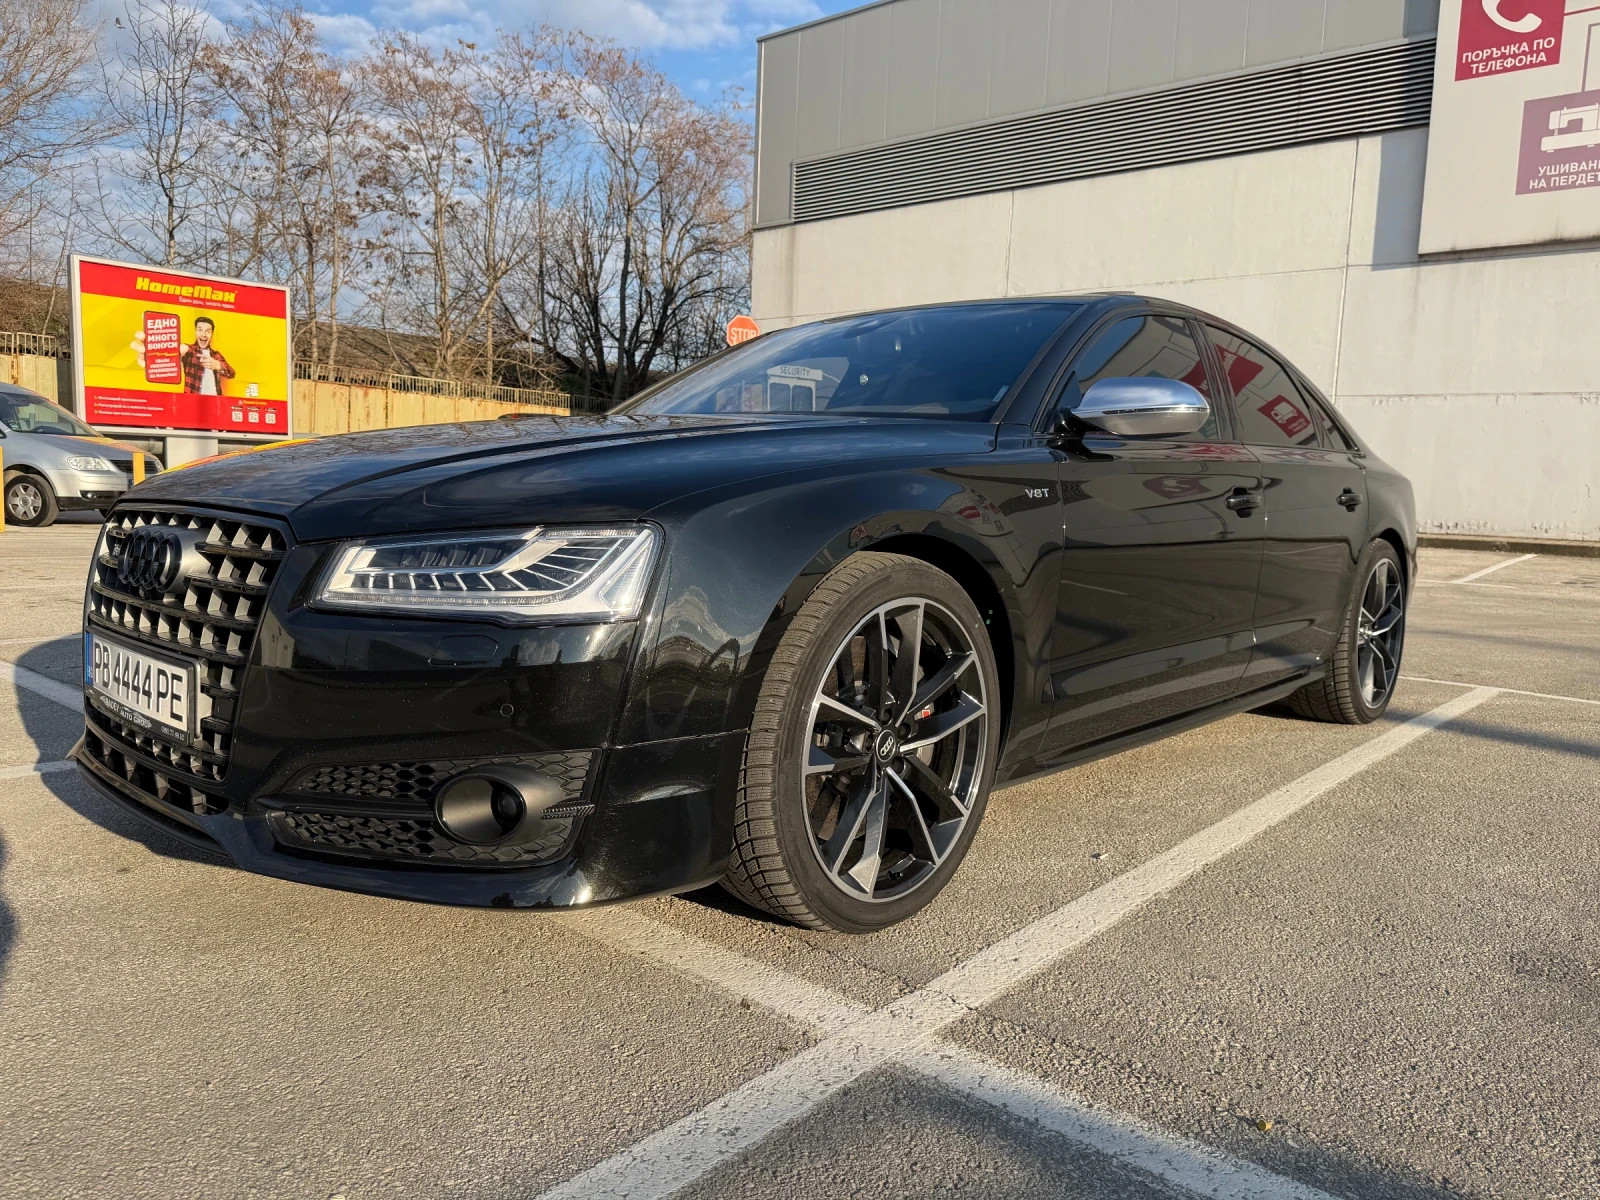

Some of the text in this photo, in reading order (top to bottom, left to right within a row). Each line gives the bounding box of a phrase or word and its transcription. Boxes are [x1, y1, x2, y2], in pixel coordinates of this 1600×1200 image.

[1462, 37, 1555, 63] ПОРЪЧКА ПО
[1470, 51, 1547, 74] ТЕЛЕФОНА
[1538, 159, 1600, 177] УШИВАН
[1529, 178, 1547, 189] НА
[135, 276, 236, 303] HomeMax
[147, 318, 178, 330] ЕДНО
[147, 333, 178, 343] МНОГО
[730, 327, 757, 341] STOP
[147, 341, 178, 350] БОНУСИ
[779, 366, 811, 377] SECURITY
[1024, 488, 1050, 499] V8T
[94, 641, 184, 723] PB 4444 PE
[120, 709, 152, 729] AUTO GROUP
